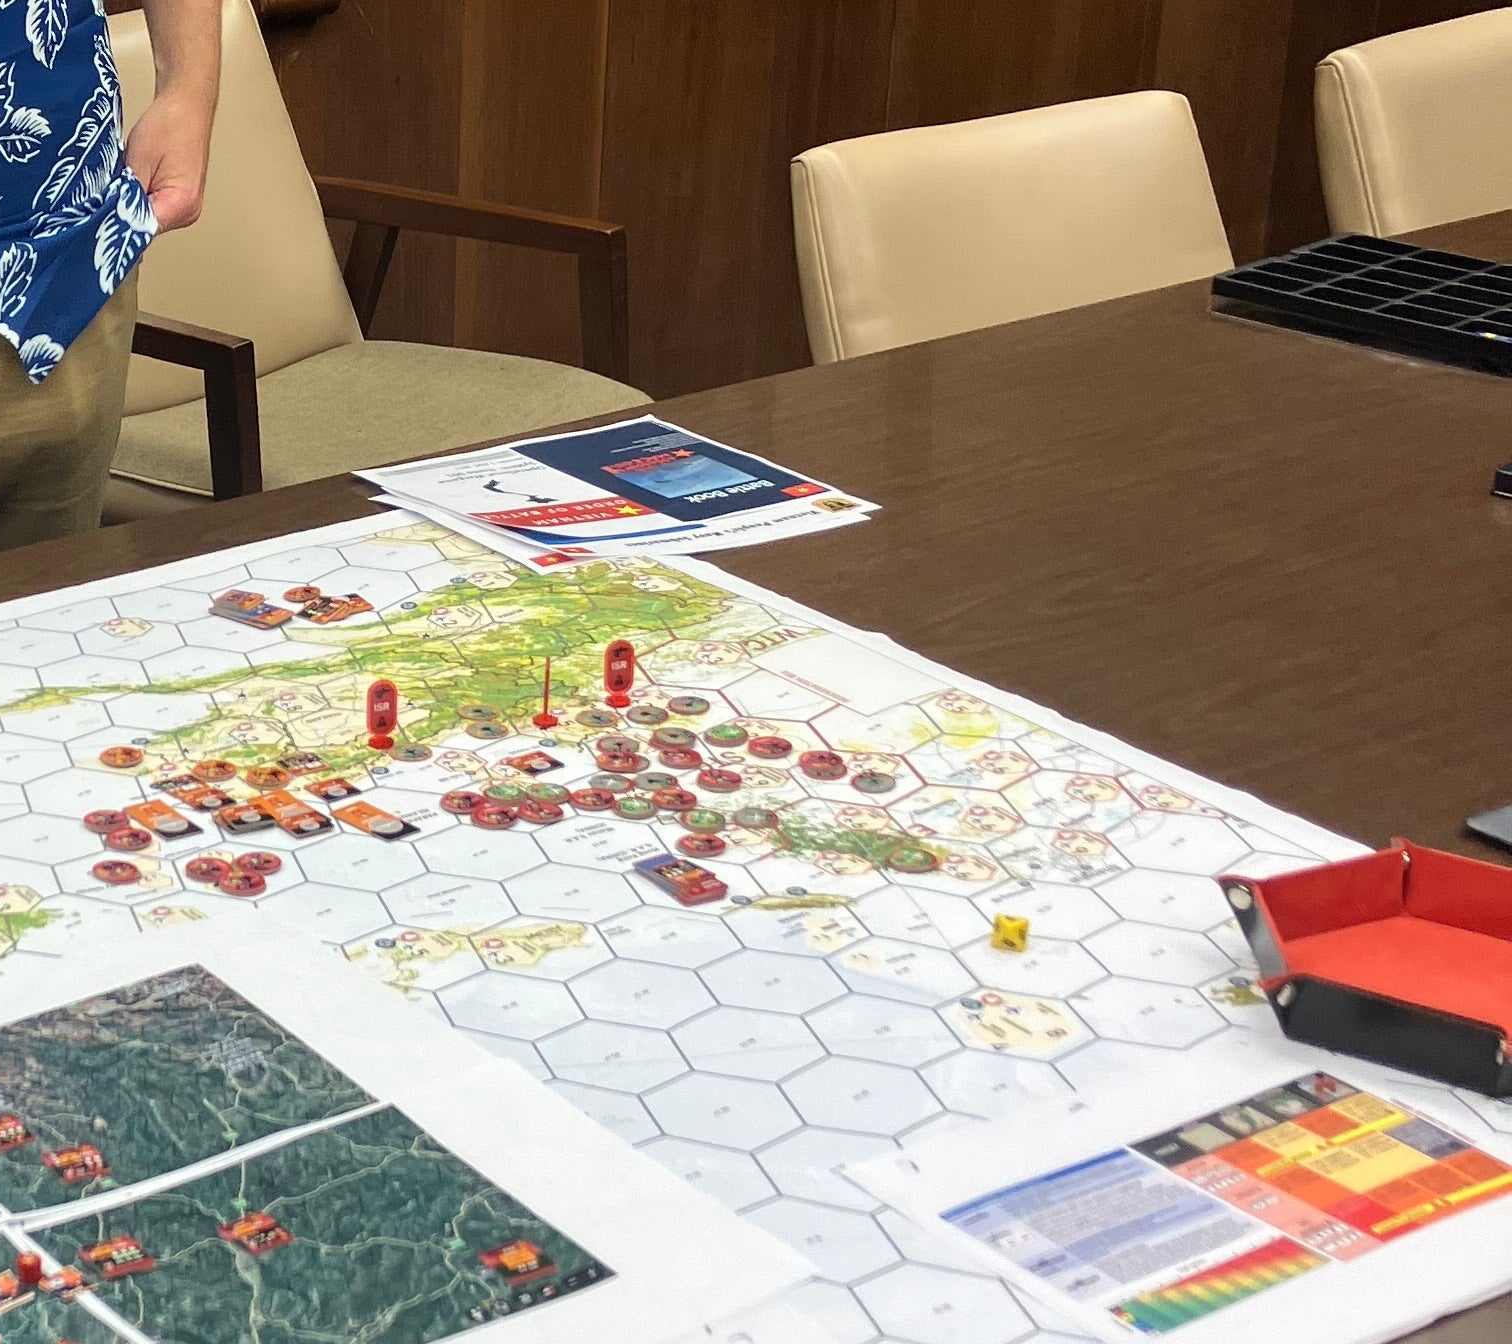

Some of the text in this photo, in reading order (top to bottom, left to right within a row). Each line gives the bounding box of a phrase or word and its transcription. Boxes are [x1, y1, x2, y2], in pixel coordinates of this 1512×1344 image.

[683, 479, 776, 504] Battle Book
[548, 506, 568, 515] OF
[574, 499, 627, 512] ORDER
[531, 512, 613, 526] VIETNAM
[610, 660, 628, 671] ISR
[374, 702, 390, 712] ISR
